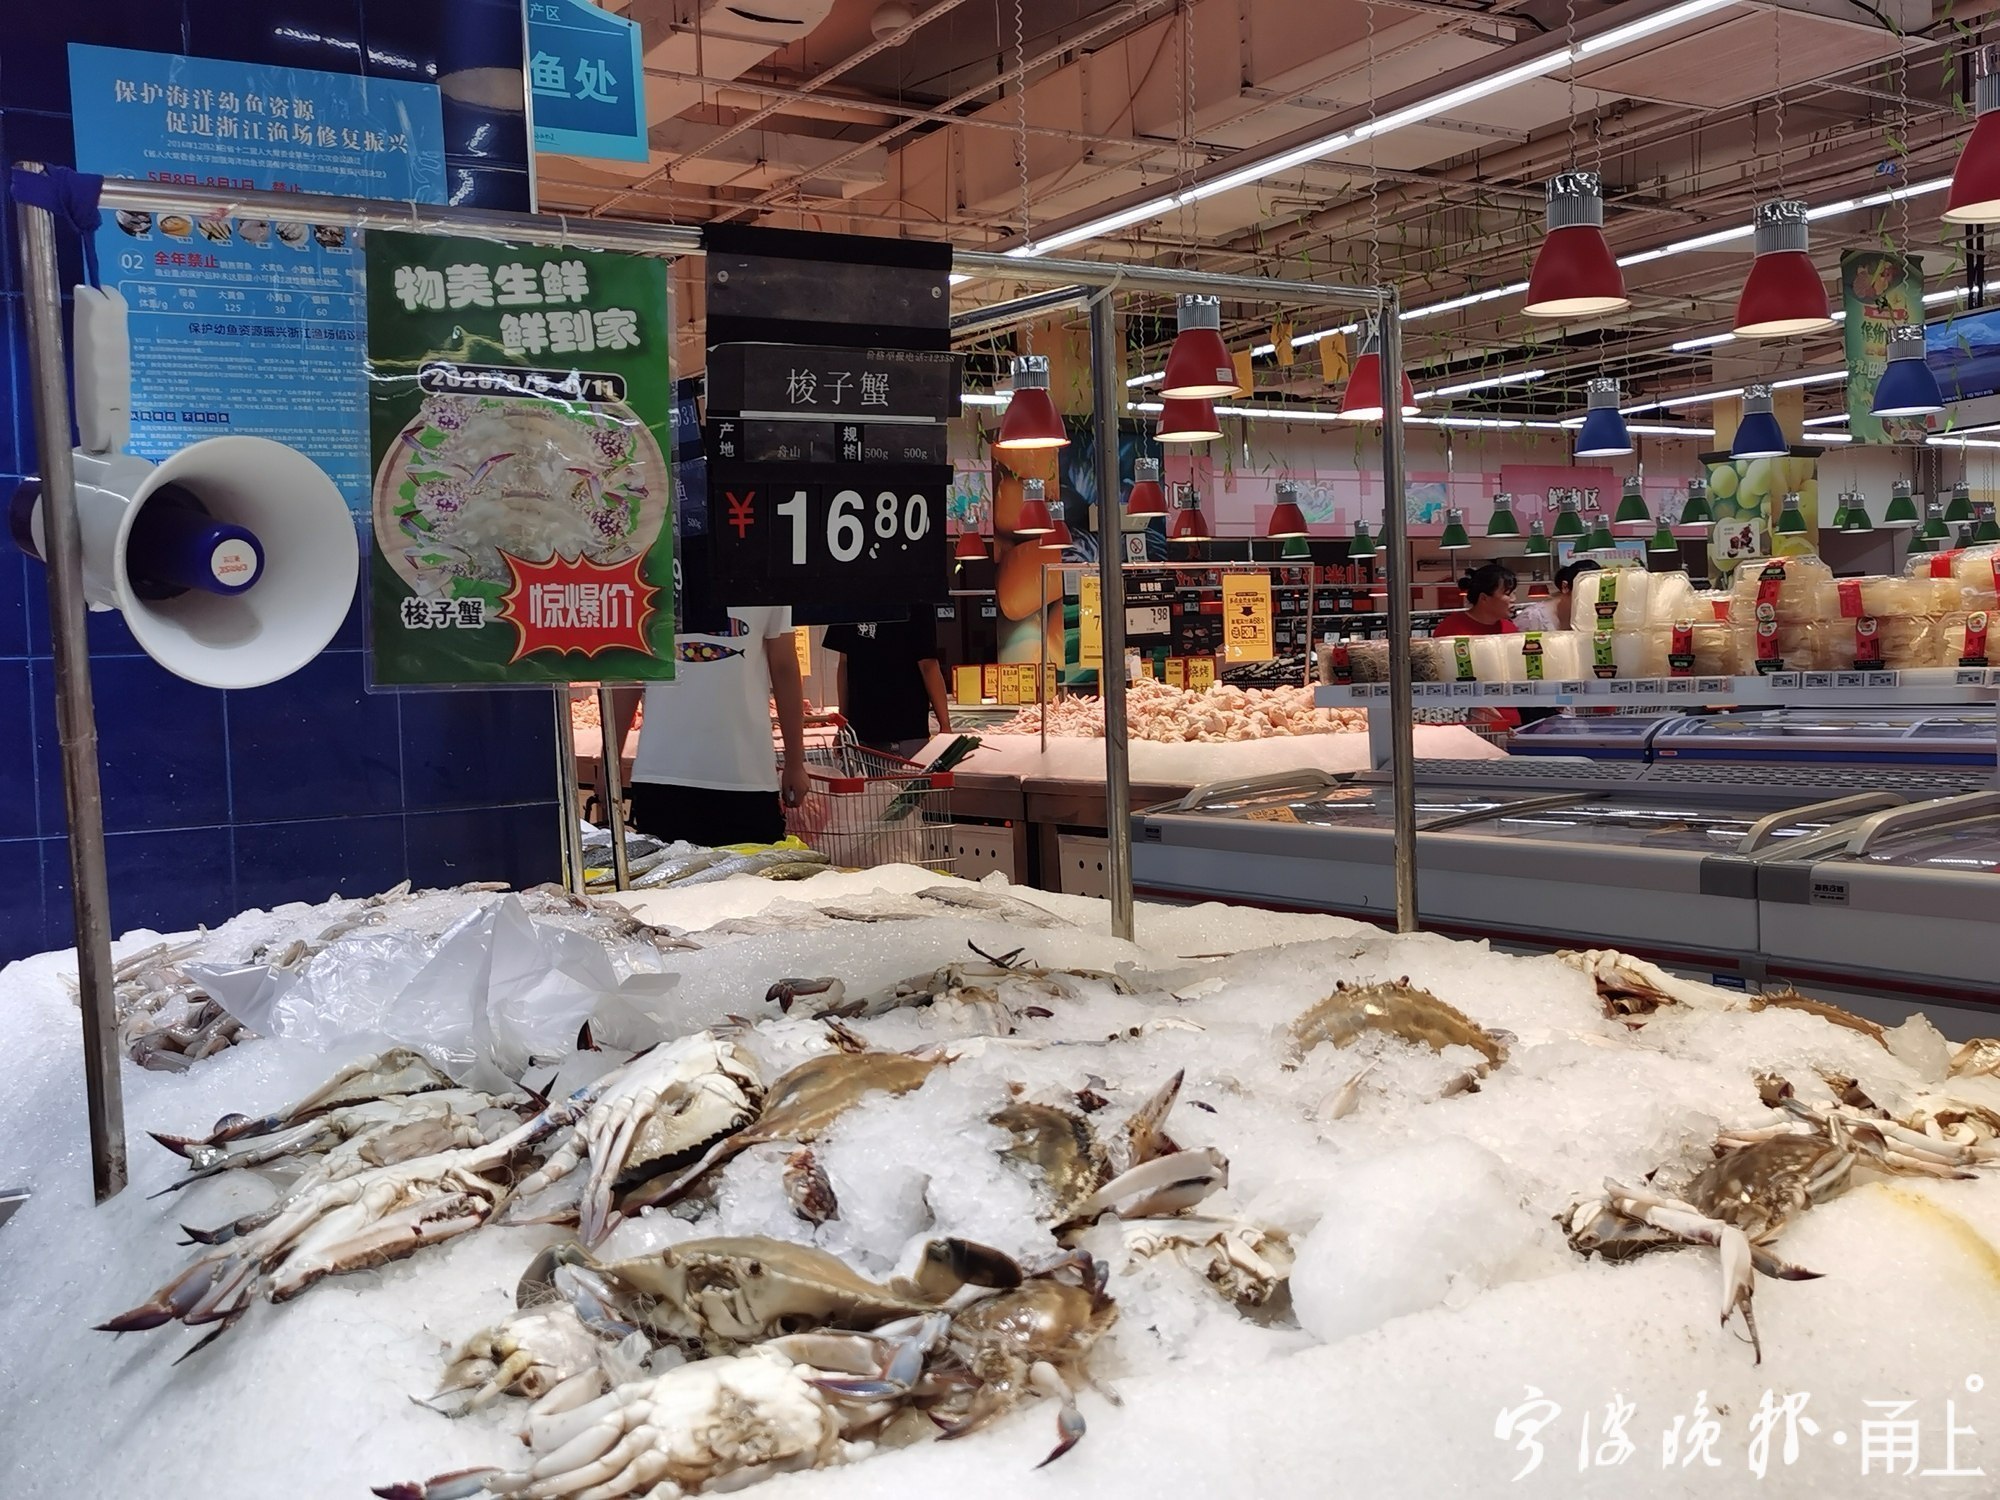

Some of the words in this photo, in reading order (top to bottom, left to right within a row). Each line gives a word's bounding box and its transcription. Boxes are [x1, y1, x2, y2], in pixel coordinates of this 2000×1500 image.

[530, 3, 560, 21] 产区
[531, 51, 618, 103] 鱼处
[114, 79, 315, 121] 保护海洋幼鱼资源
[166, 110, 408, 153] 促进浙江渔场修复振兴
[121, 254, 144, 270] 02
[155, 251, 219, 268] 全年禁止
[394, 261, 589, 309] 物美生鲜
[183, 301, 195, 310] 60
[225, 304, 241, 312] 125
[275, 306, 286, 314] 30
[316, 308, 328, 317] 60
[499, 308, 640, 355] 鲜到家
[786, 368, 890, 407] 梭子蟹
[719, 422, 735, 458] 产地
[843, 426, 858, 460] 规格
[864, 448, 889, 460] 500g
[904, 448, 928, 460] 500g
[403, 597, 485, 630] 梭子蟹
[528, 583, 635, 630] 惊爆价
